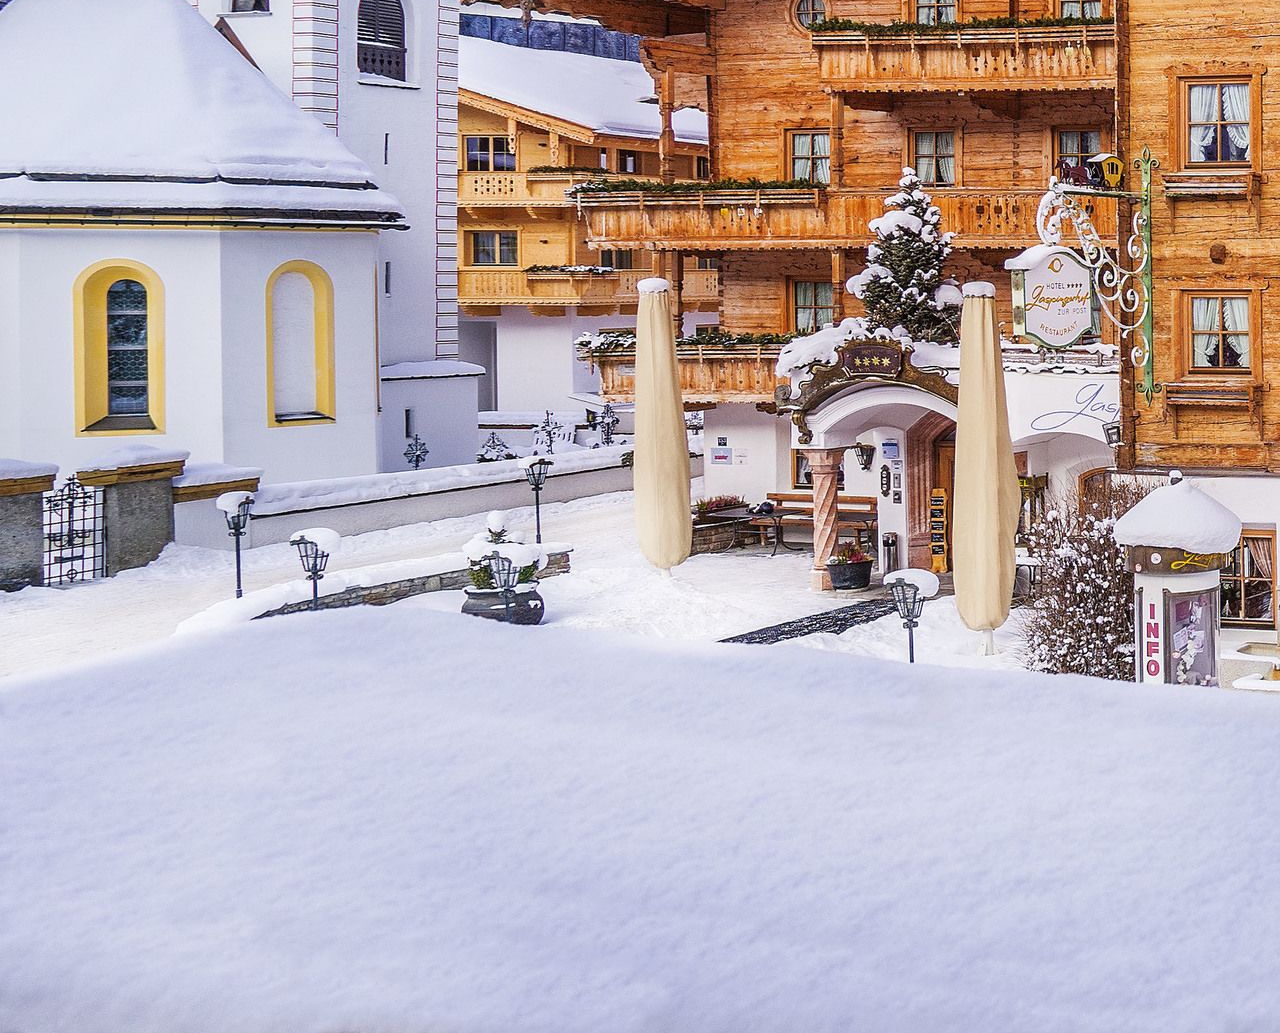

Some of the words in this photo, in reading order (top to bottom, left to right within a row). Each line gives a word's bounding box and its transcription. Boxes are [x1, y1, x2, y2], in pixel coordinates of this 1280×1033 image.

[1046, 282, 1065, 290] HOTEL
[1057, 308, 1069, 316] ZUR
[1073, 307, 1087, 315] POST
[1039, 320, 1078, 336] RESTAURANT
[1146, 603, 1160, 677] INFO
